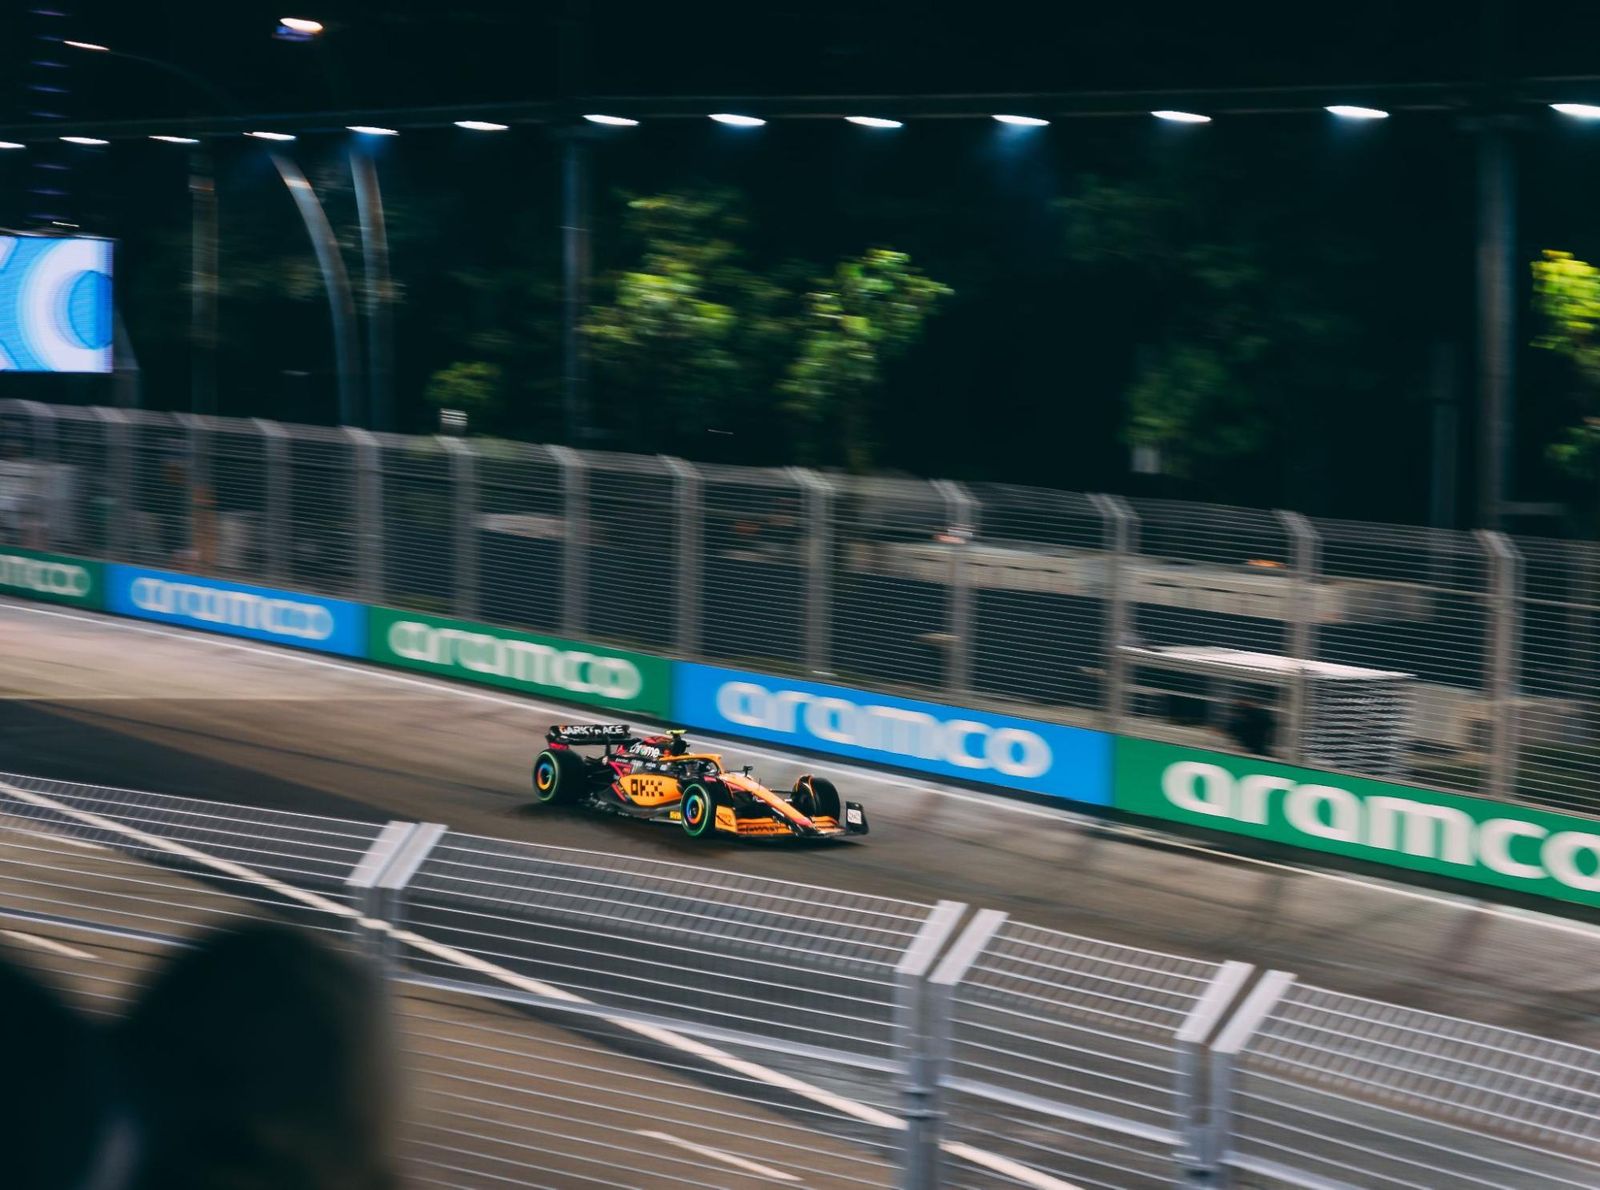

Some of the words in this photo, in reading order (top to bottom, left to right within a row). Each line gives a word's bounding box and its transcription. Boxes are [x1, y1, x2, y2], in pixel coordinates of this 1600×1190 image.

[131, 577, 334, 640] aramco
[387, 620, 641, 699] aramco
[717, 680, 1053, 778] aramco
[631, 779, 664, 797] OKX
[1161, 760, 1600, 892] aramco
